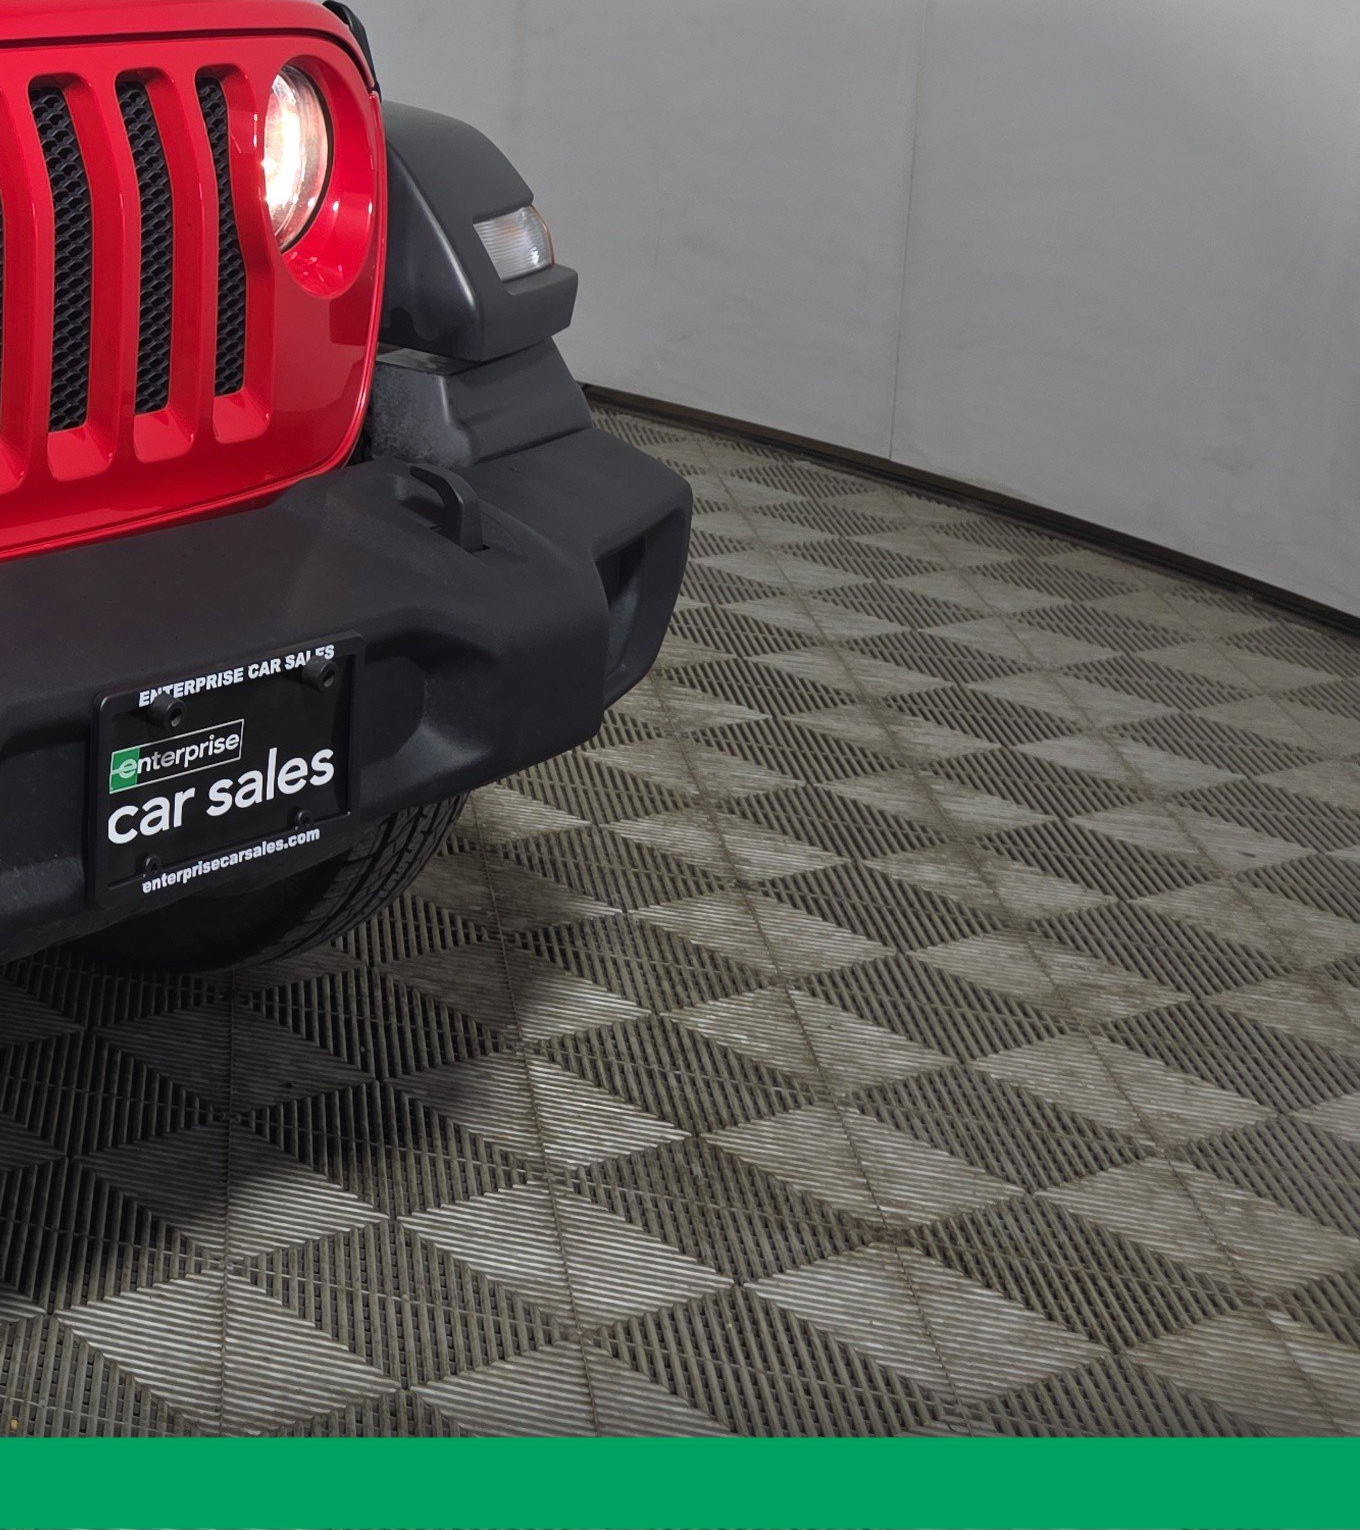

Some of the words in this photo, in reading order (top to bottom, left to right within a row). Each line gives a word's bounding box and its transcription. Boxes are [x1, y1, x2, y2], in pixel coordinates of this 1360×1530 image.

[248, 658, 281, 679] CAR
[117, 733, 240, 779] enterprise
[108, 787, 195, 845] car
[206, 747, 335, 817] sales
[142, 828, 320, 894] enterprisecarsales.com
